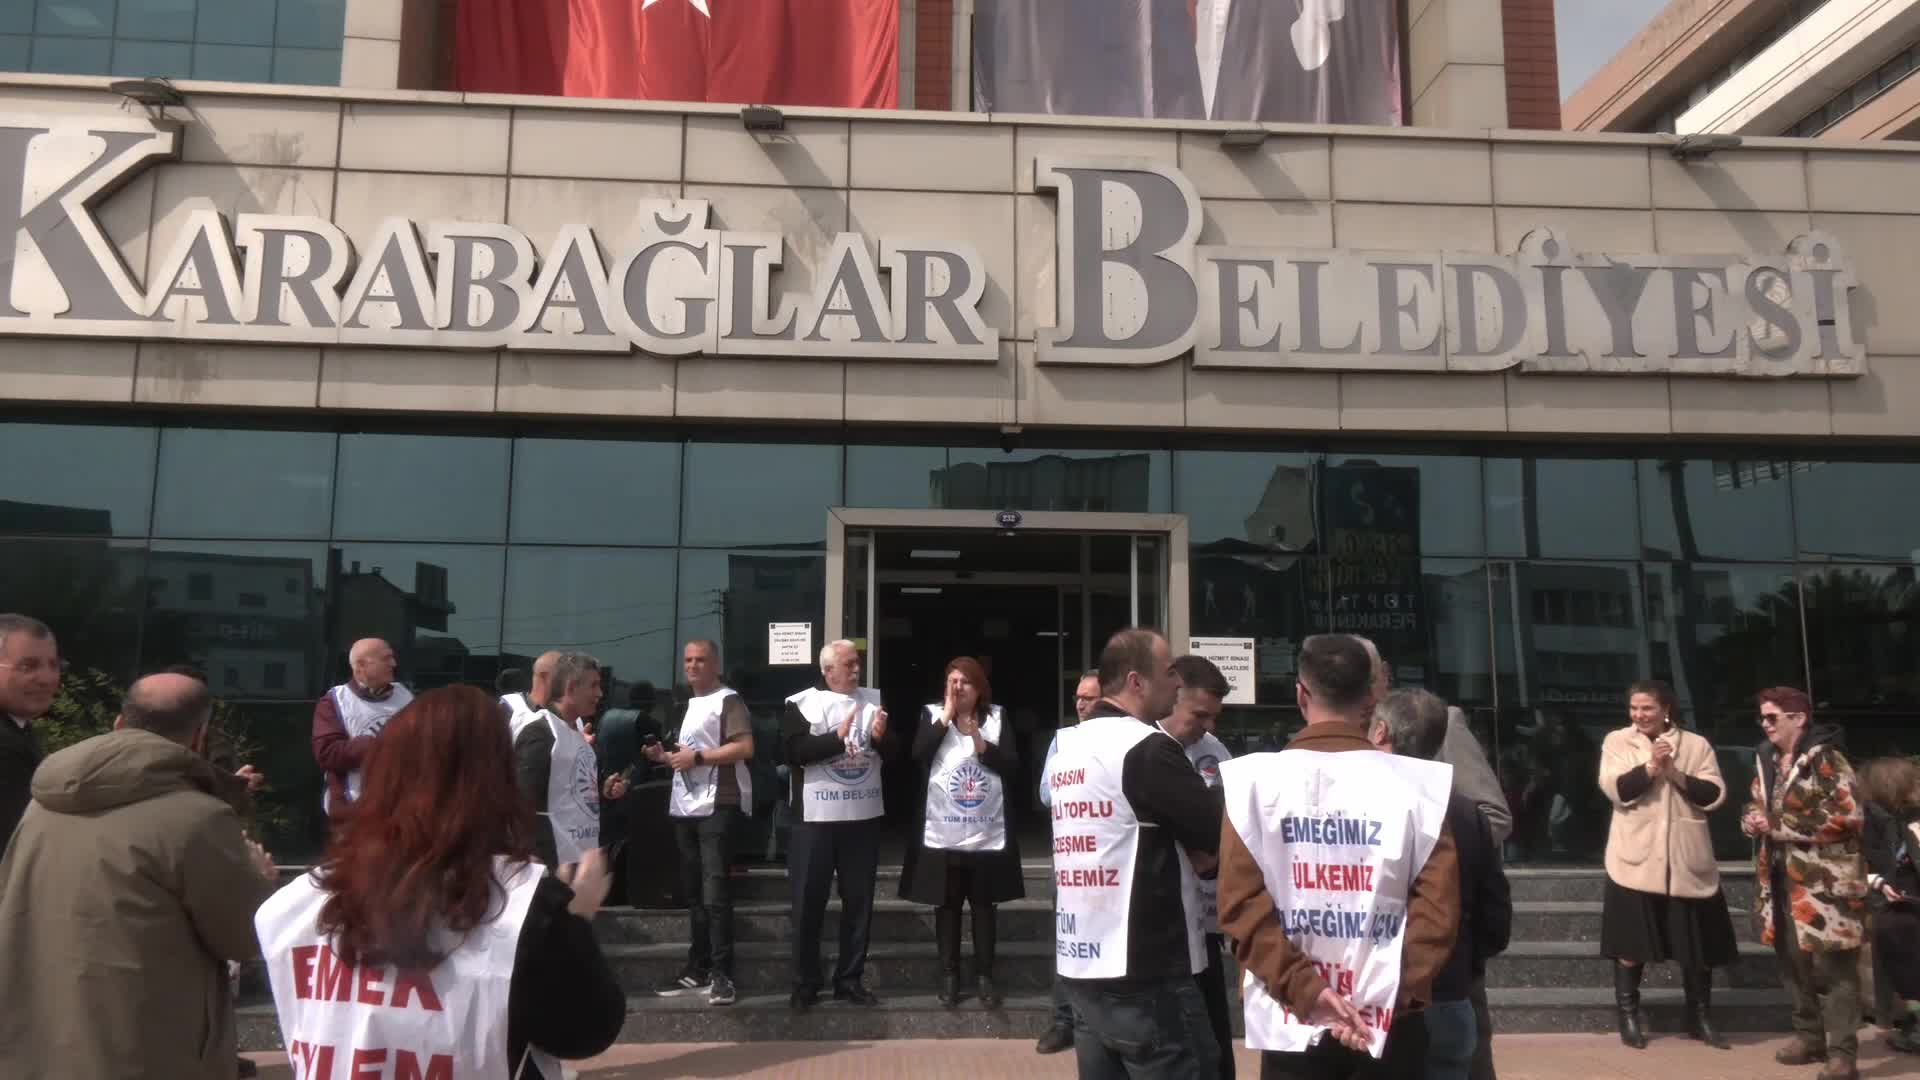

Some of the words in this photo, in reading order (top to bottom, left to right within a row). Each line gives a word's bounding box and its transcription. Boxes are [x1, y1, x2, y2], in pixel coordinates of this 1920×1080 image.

[0, 126, 985, 345] KARABAĞLAR
[1050, 166, 1855, 359] BELEDİYESİ
[1064, 801, 1113, 819] TOPLU
[1280, 811, 1383, 846] EMEĞİMİZ
[1293, 855, 1374, 892] ÜLKEMİZ
[292, 944, 443, 1011] EMEK
